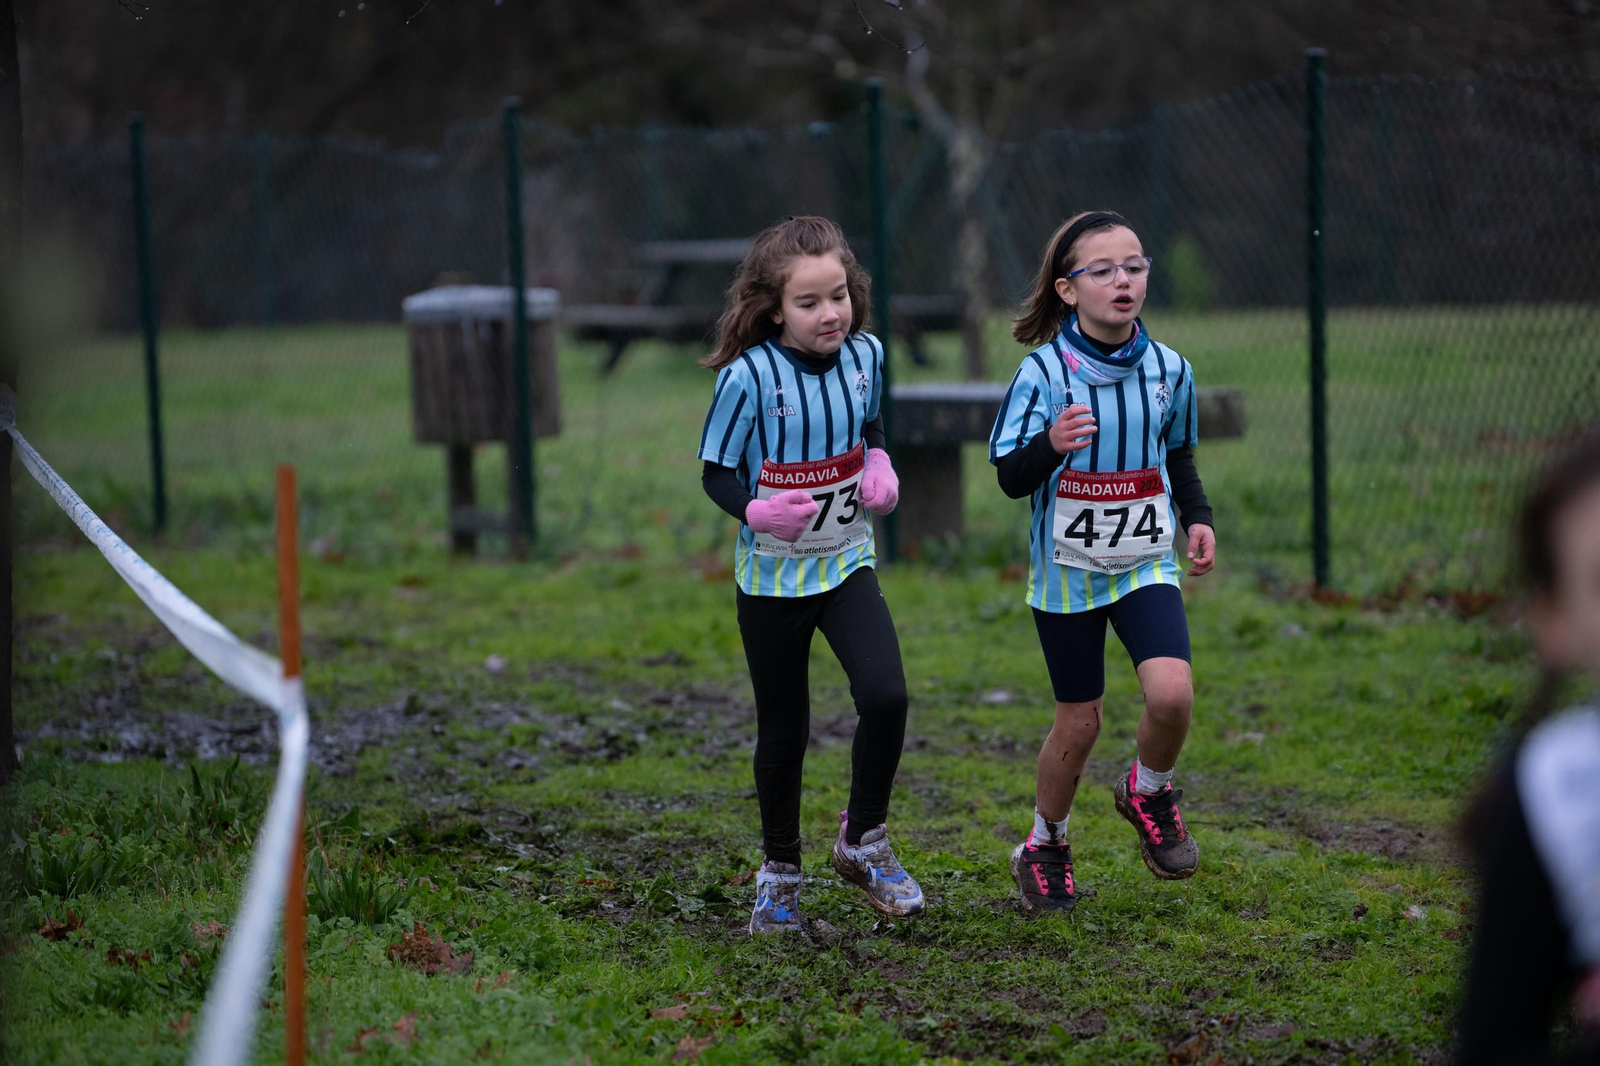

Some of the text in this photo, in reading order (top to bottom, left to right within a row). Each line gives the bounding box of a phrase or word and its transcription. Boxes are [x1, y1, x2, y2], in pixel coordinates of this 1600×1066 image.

[766, 404, 796, 417] UXÍA
[1051, 402, 1086, 415] VE
[760, 453, 863, 484] RIBADAVIA 2026
[779, 463, 815, 471] Memorial
[816, 454, 846, 468] Alejandro
[1076, 472, 1111, 481] Memorial
[1112, 472, 1144, 480] Alejandro
[1059, 479, 1136, 496] RIBADAVIA
[1064, 503, 1164, 548] 474
